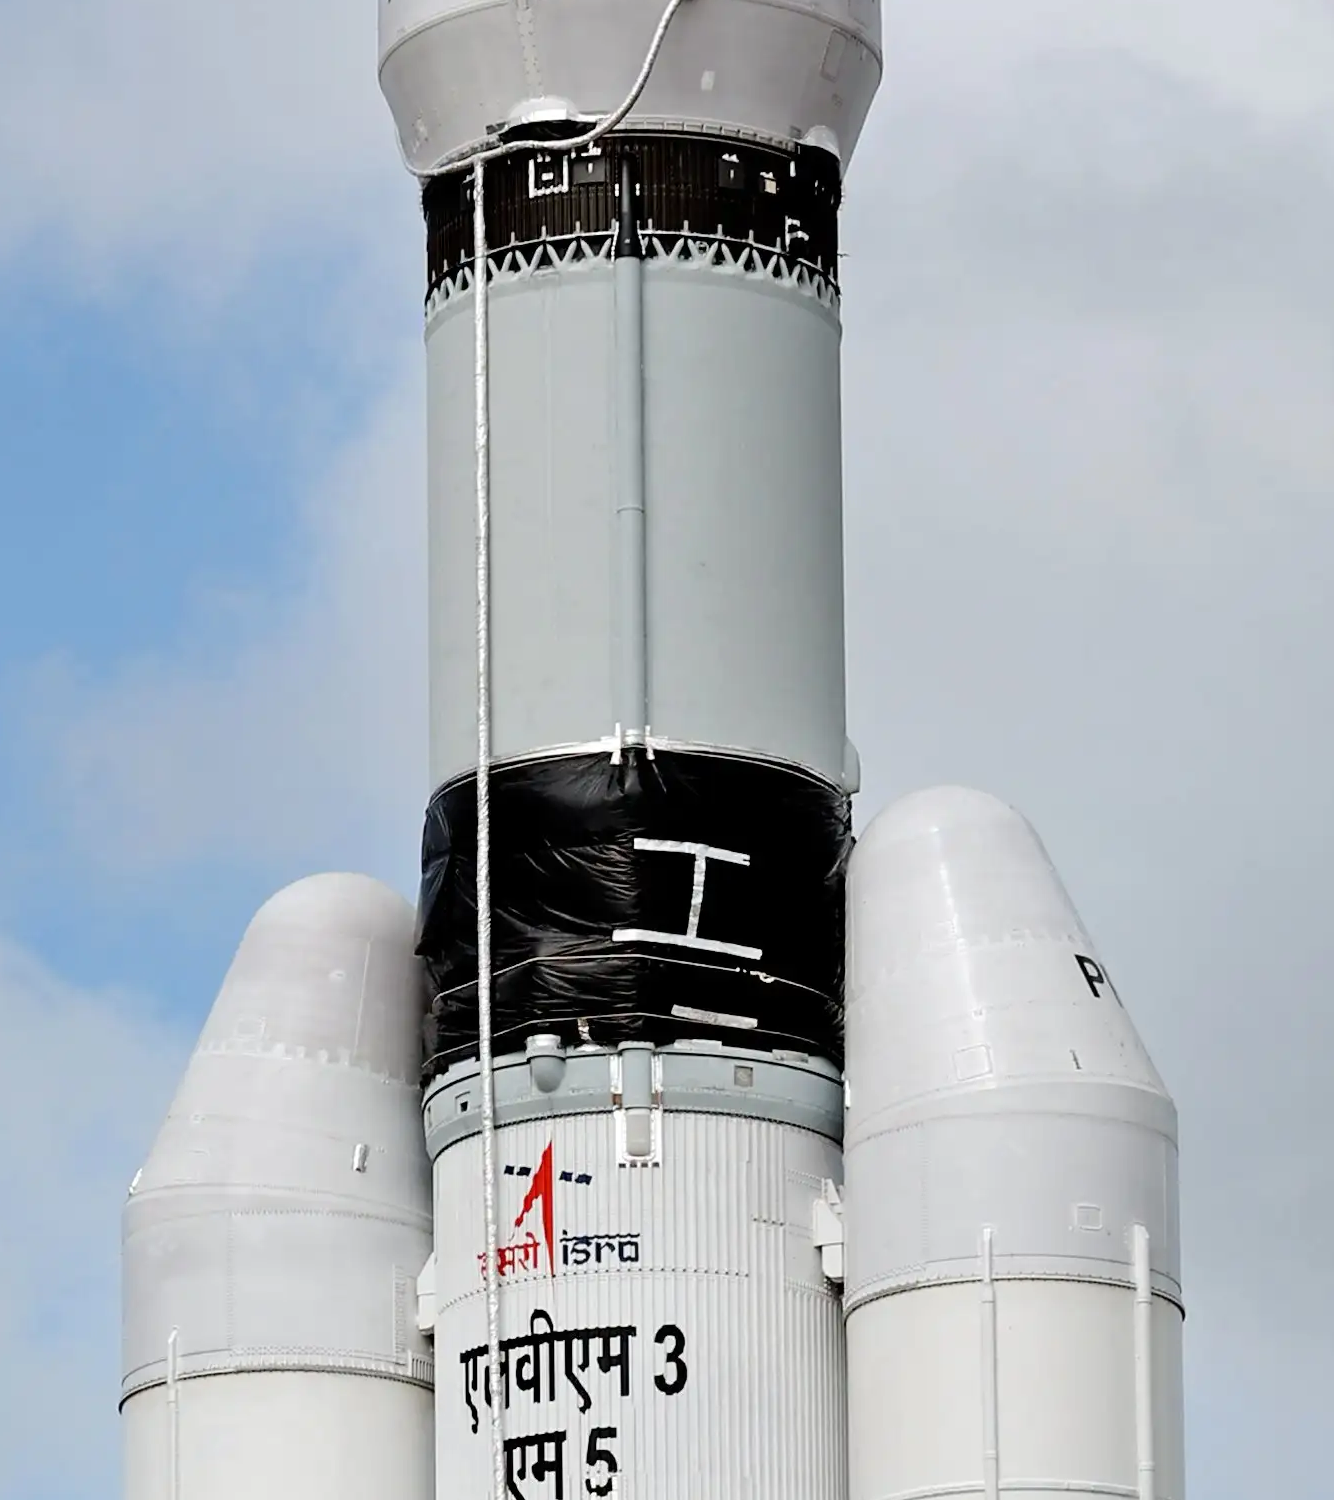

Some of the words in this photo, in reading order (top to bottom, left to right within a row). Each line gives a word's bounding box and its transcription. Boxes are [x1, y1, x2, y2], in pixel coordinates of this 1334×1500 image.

[560, 1230, 640, 1266] isro
[653, 1323, 688, 1396] 3
[585, 1426, 618, 1497] 5
